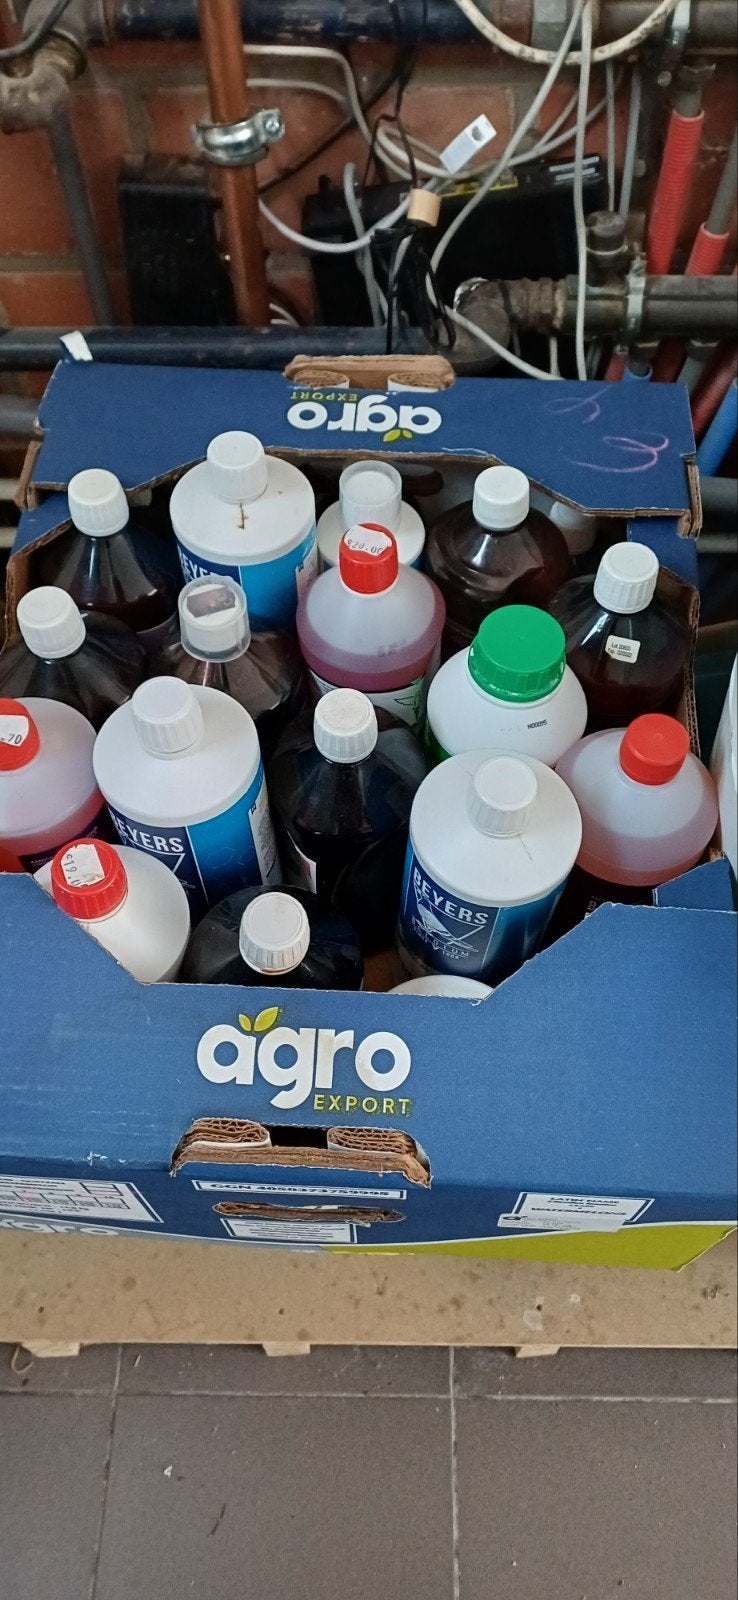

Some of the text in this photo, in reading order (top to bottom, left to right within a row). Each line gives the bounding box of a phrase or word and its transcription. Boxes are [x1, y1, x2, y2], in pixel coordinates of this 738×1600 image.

[286, 394, 443, 435] agro
[289, 391, 358, 402] EXPORT
[107, 806, 184, 853] BEYERS
[412, 866, 489, 925] BEYERS
[196, 1023, 412, 1109] agro
[313, 1093, 410, 1115] EXPORT
